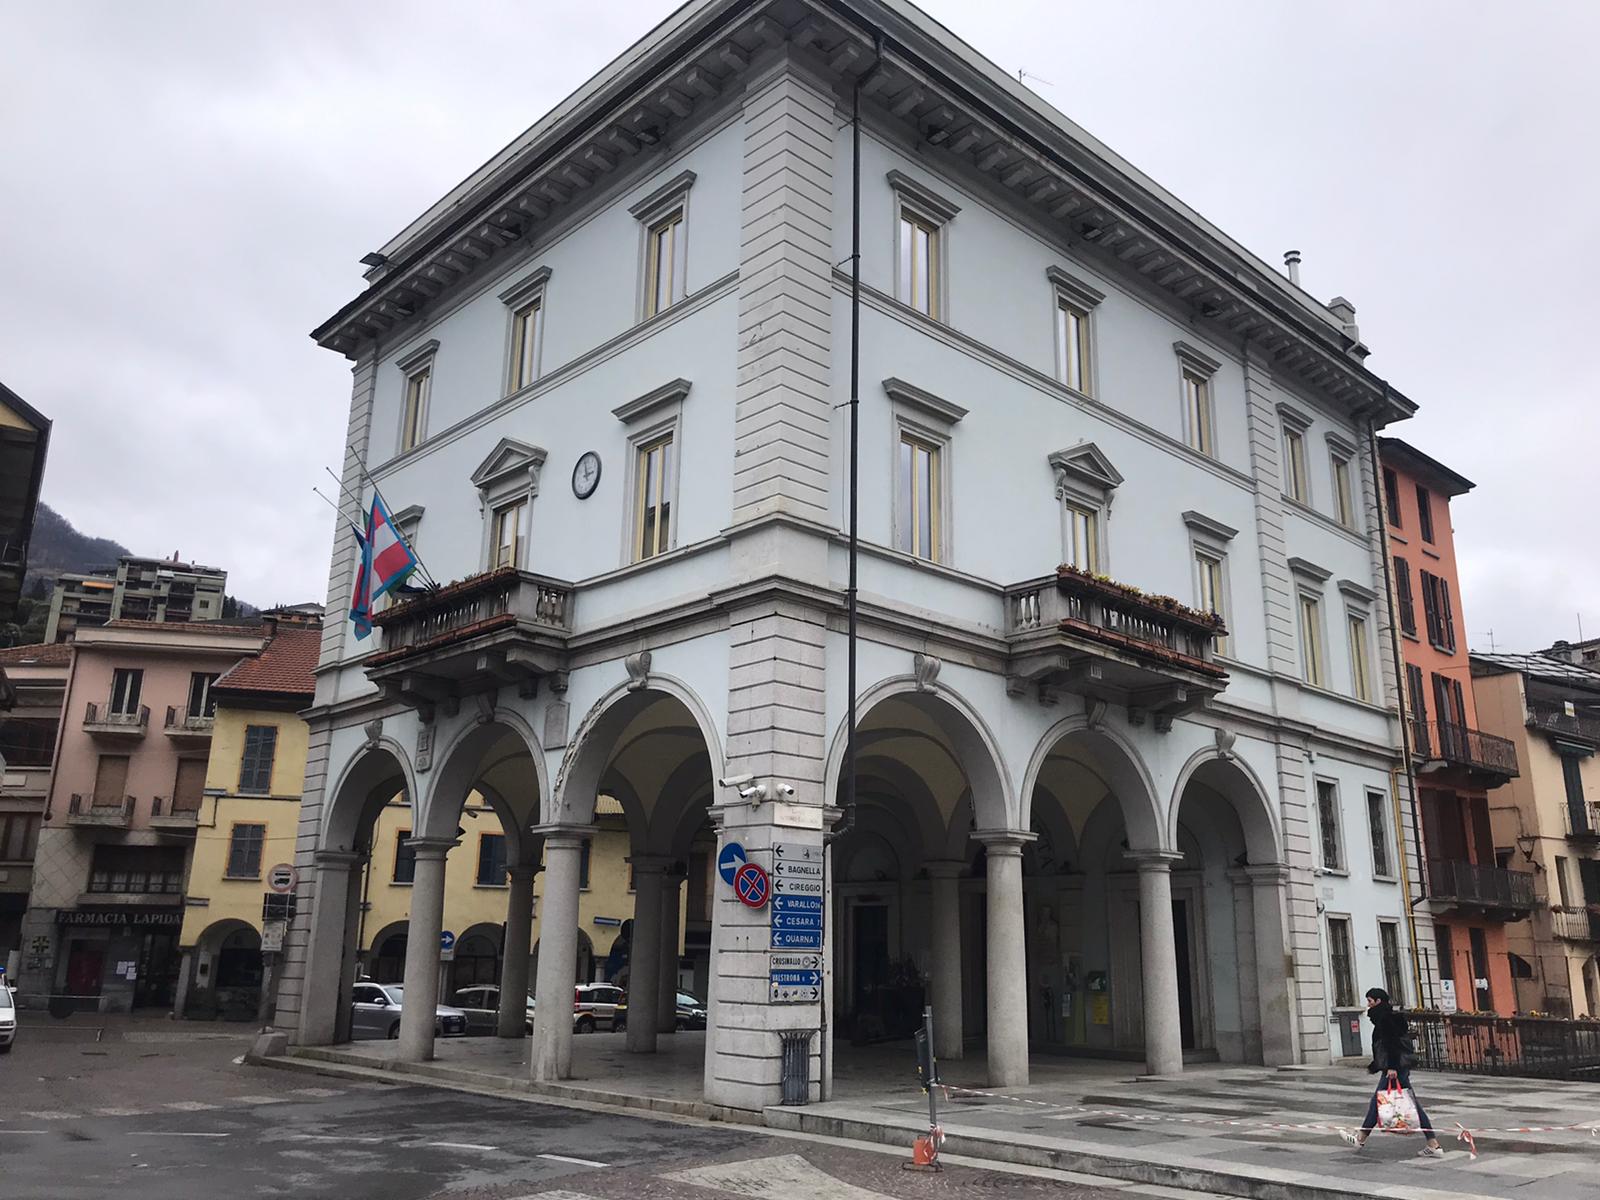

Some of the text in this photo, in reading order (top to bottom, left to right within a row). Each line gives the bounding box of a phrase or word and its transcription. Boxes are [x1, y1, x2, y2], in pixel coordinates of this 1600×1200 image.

[788, 866, 821, 875] BAGNELLA
[789, 883, 821, 892] CIREGGIO
[787, 900, 815, 909] VARALLO
[58, 912, 127, 924] FARMACIA
[786, 917, 815, 926] CESARA
[785, 934, 814, 943] QUARNA
